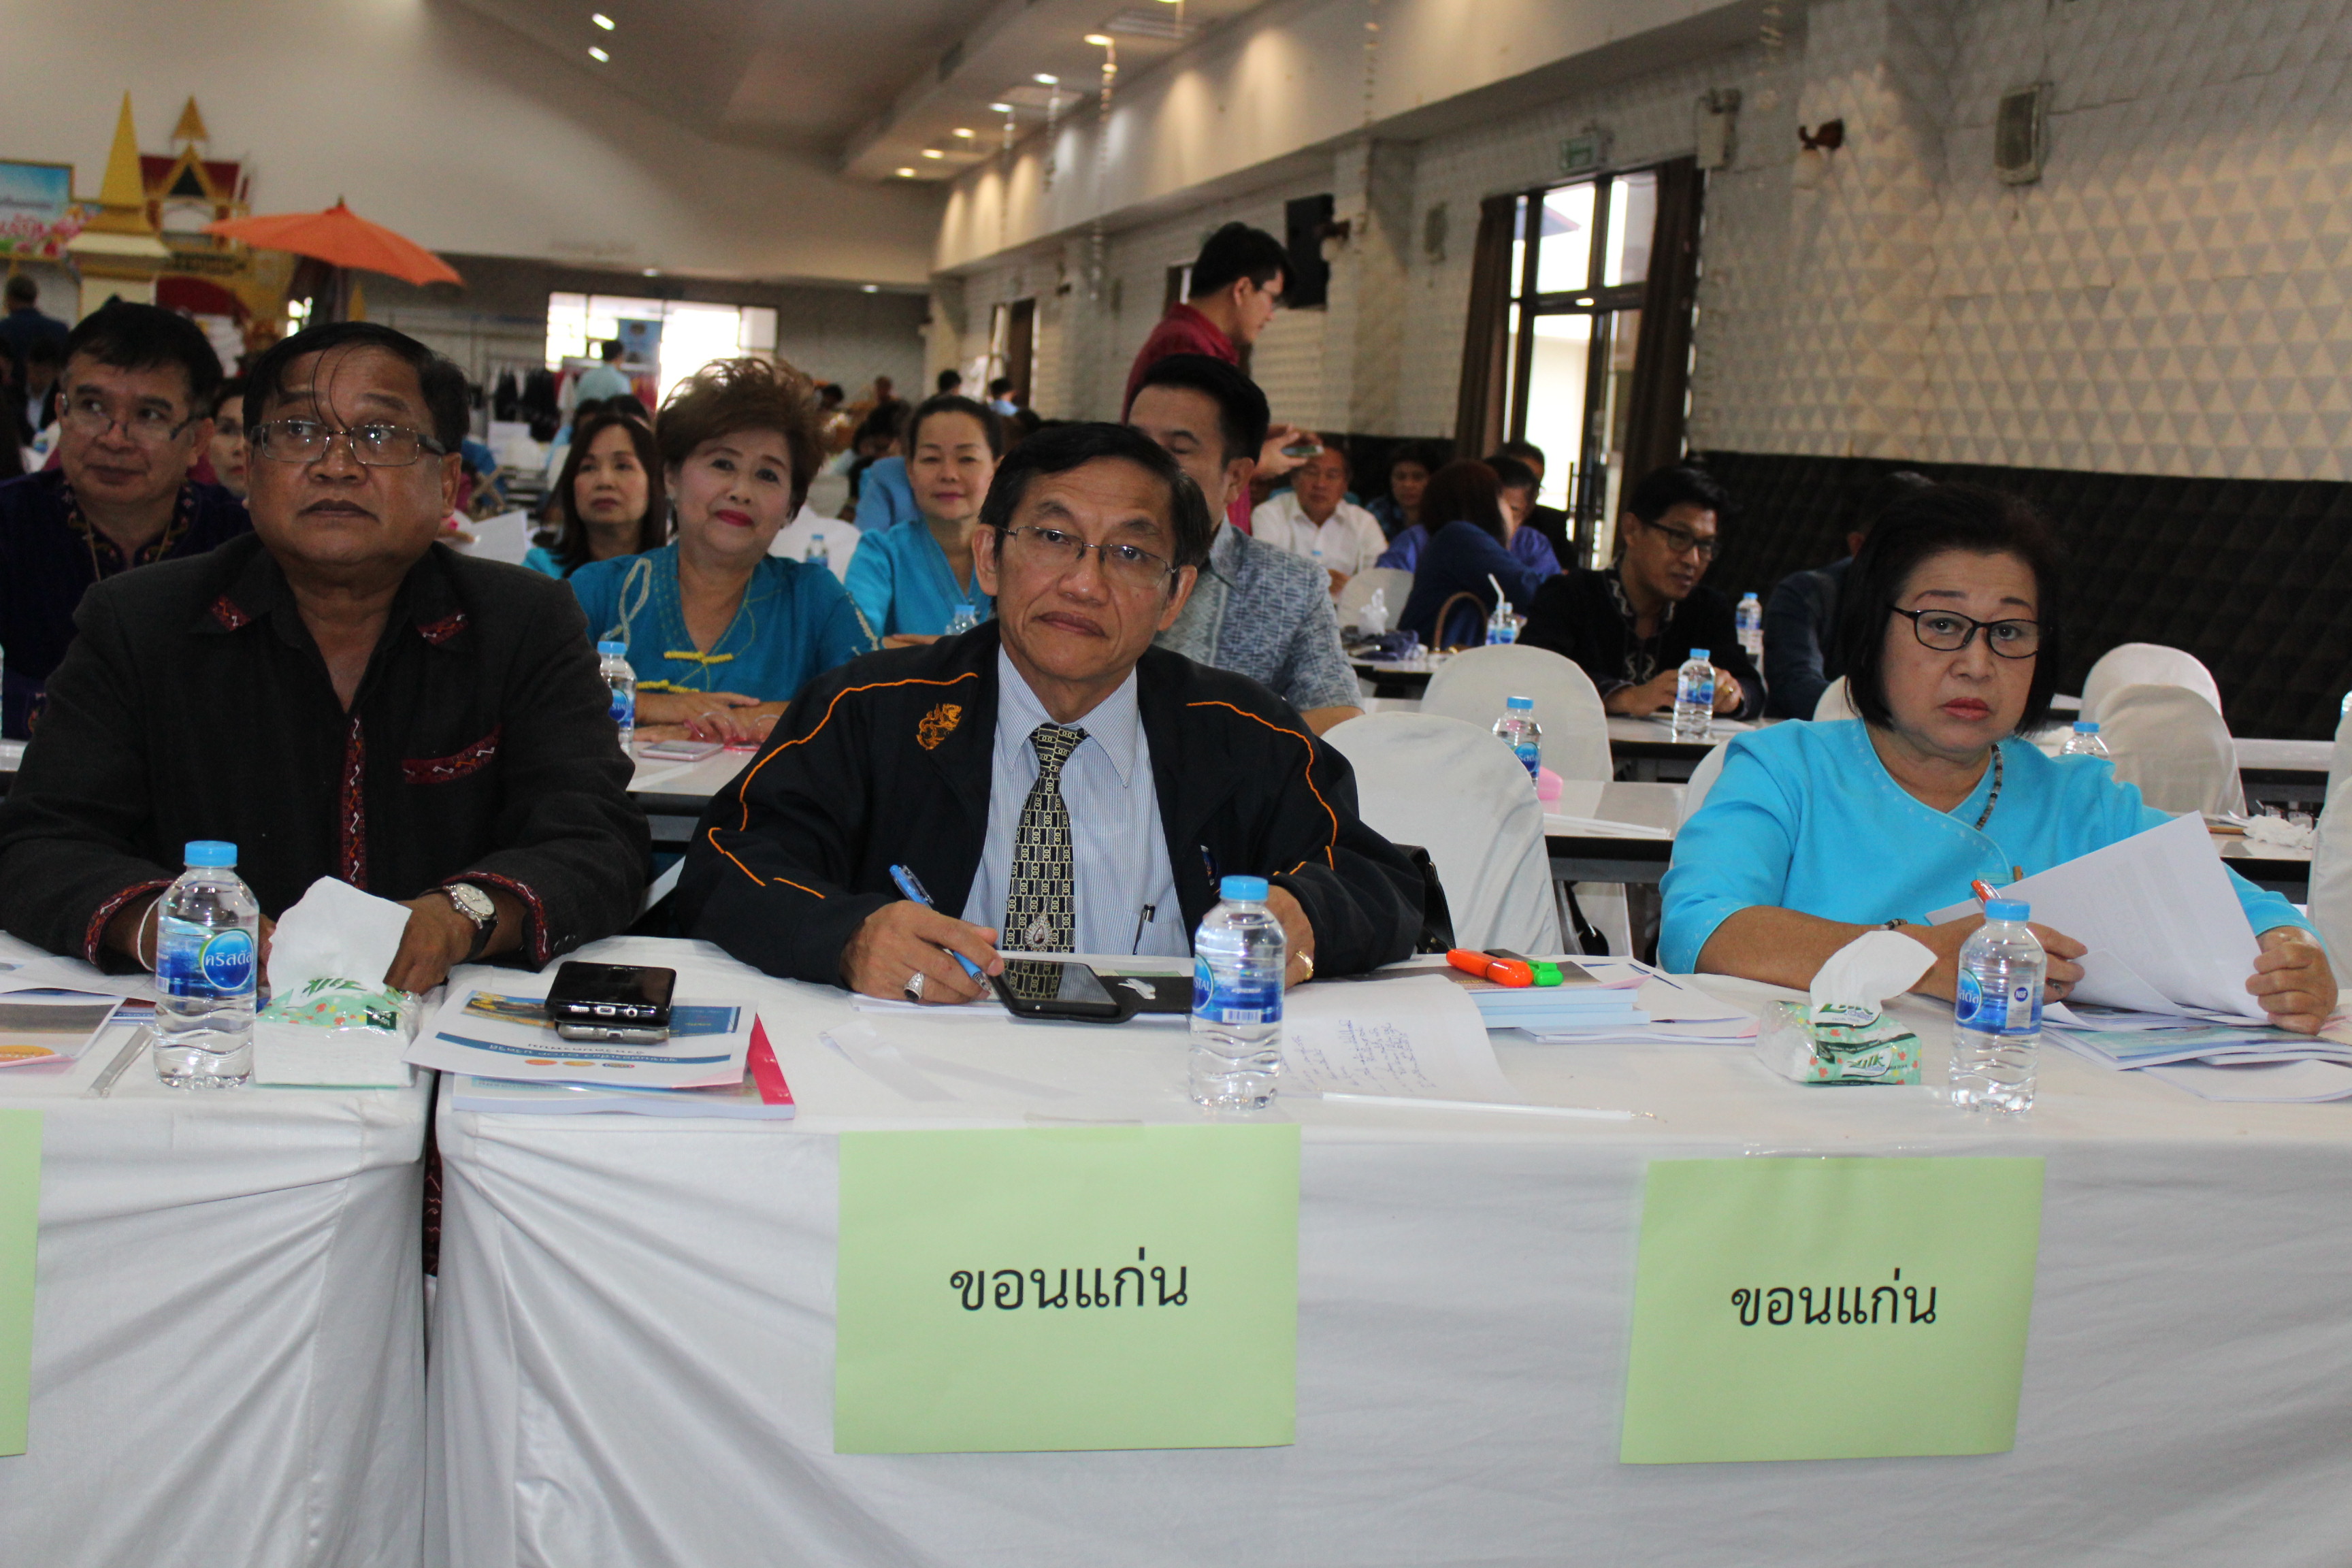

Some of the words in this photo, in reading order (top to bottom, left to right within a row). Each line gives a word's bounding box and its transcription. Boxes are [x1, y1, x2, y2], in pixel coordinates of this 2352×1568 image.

[1193, 978, 1210, 992] STAL
[2015, 990, 2027, 999] NSF
[949, 1247, 1188, 1311] ขอนแก่น
[1731, 1268, 1936, 1326] ขอนแก่น
